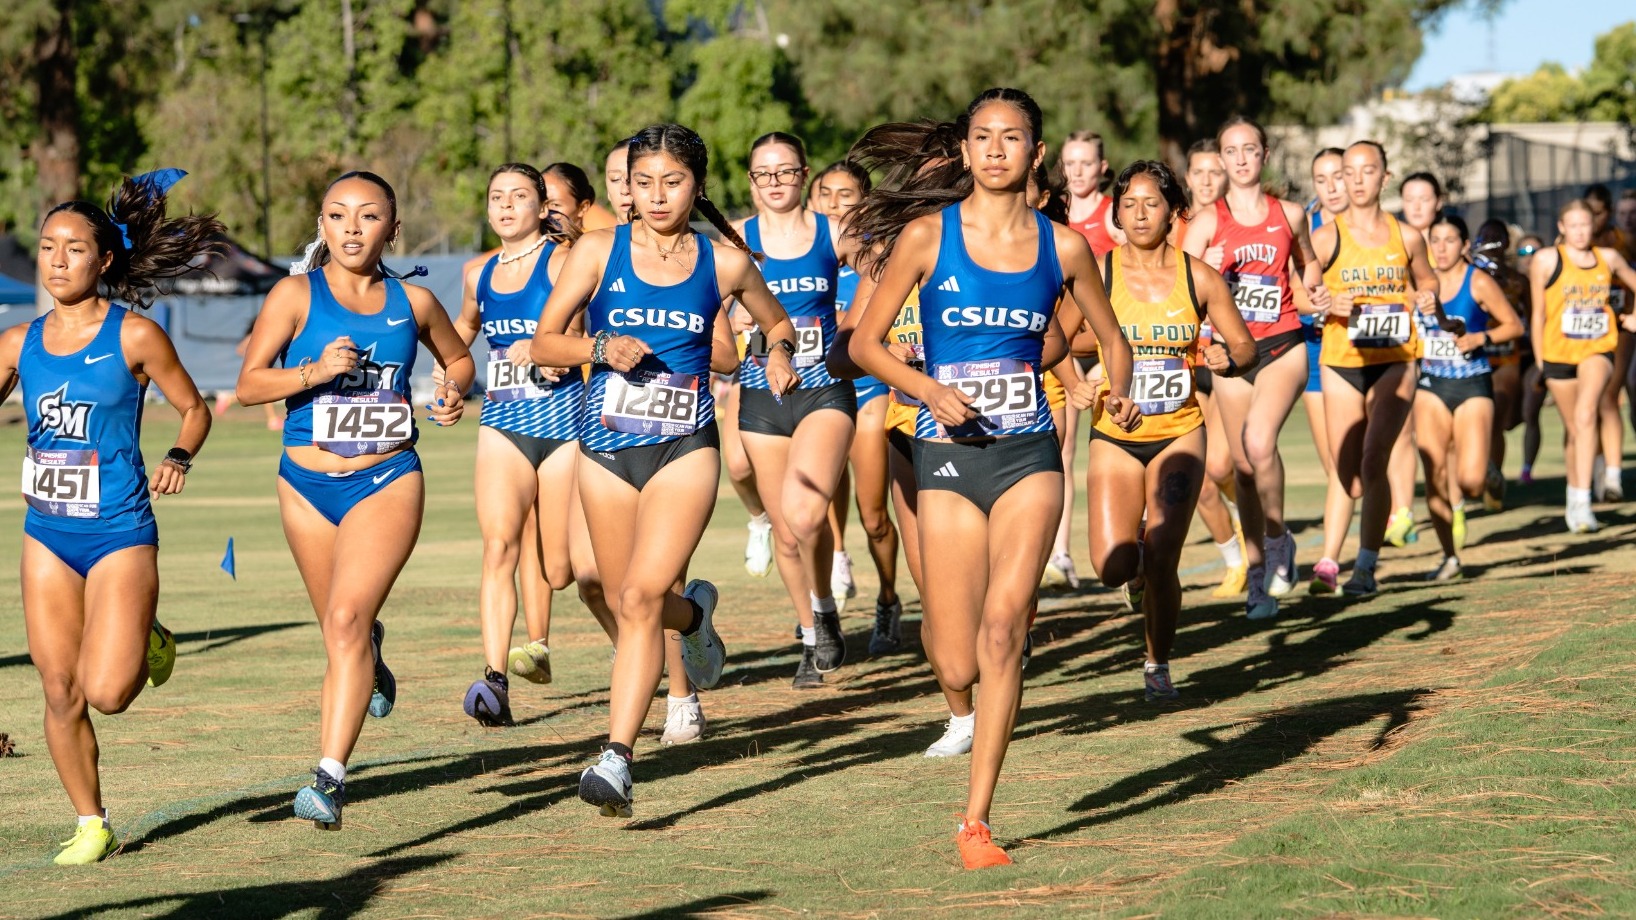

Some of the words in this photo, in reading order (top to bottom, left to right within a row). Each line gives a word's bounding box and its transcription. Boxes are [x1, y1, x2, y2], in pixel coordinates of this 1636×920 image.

[1234, 243, 1277, 268] UNLV
[766, 276, 829, 295] SUSB
[1341, 268, 1369, 282] CAL
[1232, 285, 1279, 310] 466
[482, 318, 539, 338] SUSB
[607, 307, 705, 335] CSUSB
[941, 306, 1047, 333] CSUSB
[1363, 316, 1400, 337] 1141
[1572, 315, 1603, 332] 1145
[1121, 325, 1143, 341] AL
[1151, 324, 1196, 341] POLY
[1134, 345, 1188, 358] MONA
[1430, 340, 1458, 357] 128
[970, 369, 1000, 378] RESULTS
[971, 362, 1000, 370] FINISHED
[1130, 372, 1183, 400] 1126
[614, 382, 695, 421] 1288
[38, 386, 95, 443] SM
[326, 406, 409, 438] 1452
[33, 465, 90, 500] 1451
